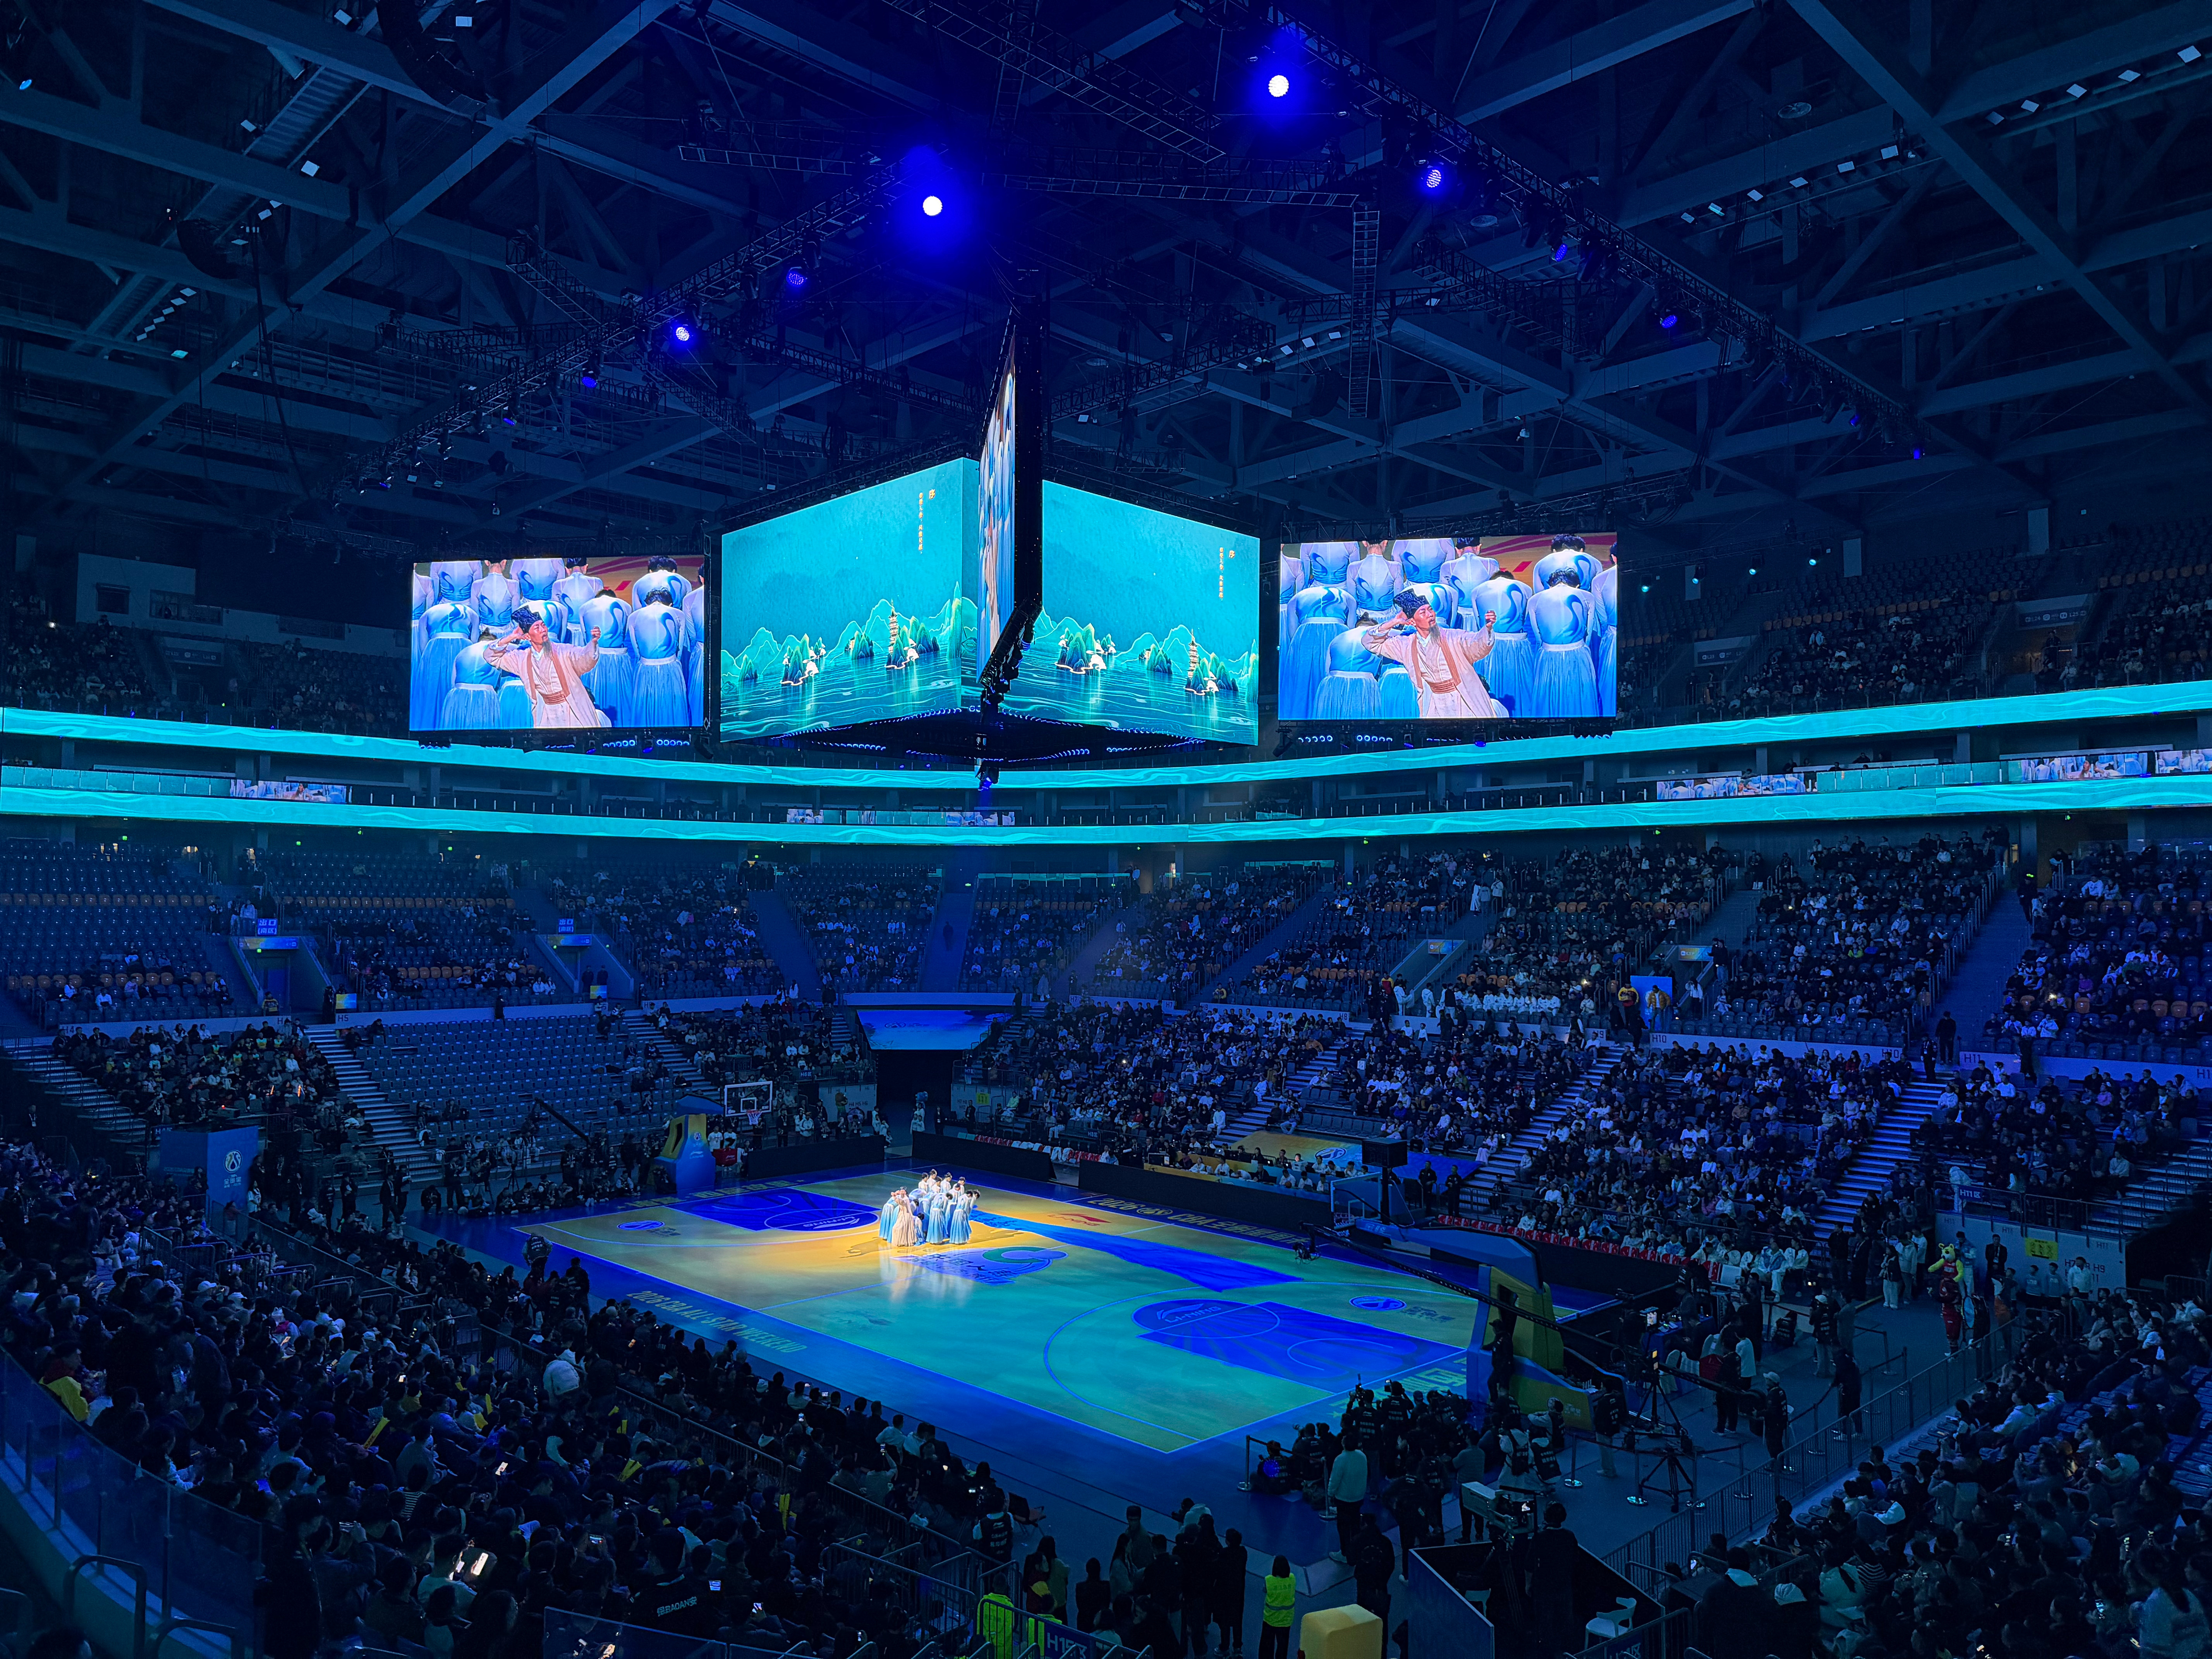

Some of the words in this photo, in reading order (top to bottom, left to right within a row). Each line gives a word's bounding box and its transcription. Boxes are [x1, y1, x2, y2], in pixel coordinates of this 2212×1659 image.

[1652, 1034, 1667, 1043] H10
[1964, 1054, 1980, 1063] H11
[1960, 1189, 1981, 1199] H11区
[1087, 1197, 1142, 1210] 2026
[2093, 1263, 2105, 1273] H9
[1164, 1306, 1223, 1323] LI-NING
